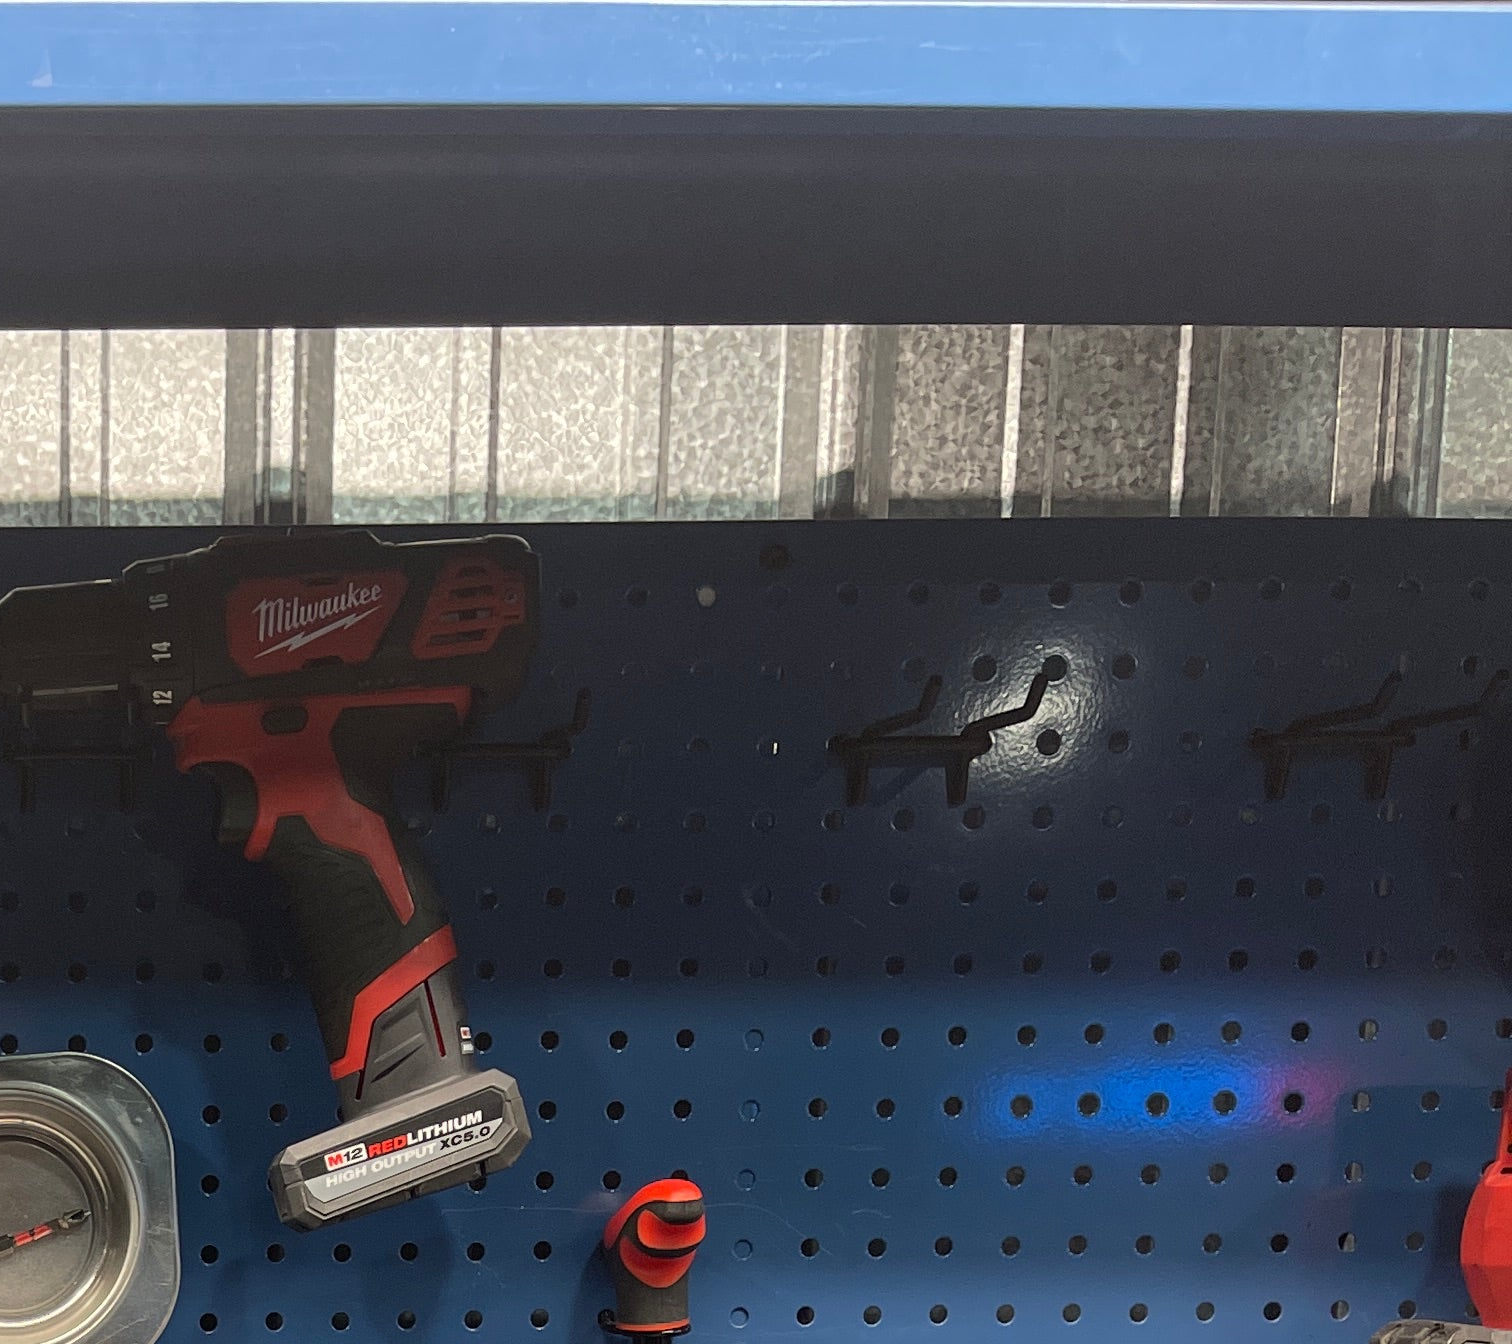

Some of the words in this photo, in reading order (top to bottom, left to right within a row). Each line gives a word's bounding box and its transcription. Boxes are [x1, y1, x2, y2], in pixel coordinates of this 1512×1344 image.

[148, 593, 169, 612] 16
[252, 582, 383, 642] Milwaukee
[151, 641, 172, 663] 14
[152, 690, 173, 705] 12
[326, 1165, 367, 1188] HIGH
[371, 1142, 437, 1174] OUTPUT
[440, 1125, 491, 1150] XC5.0
[326, 1147, 365, 1168] M12
